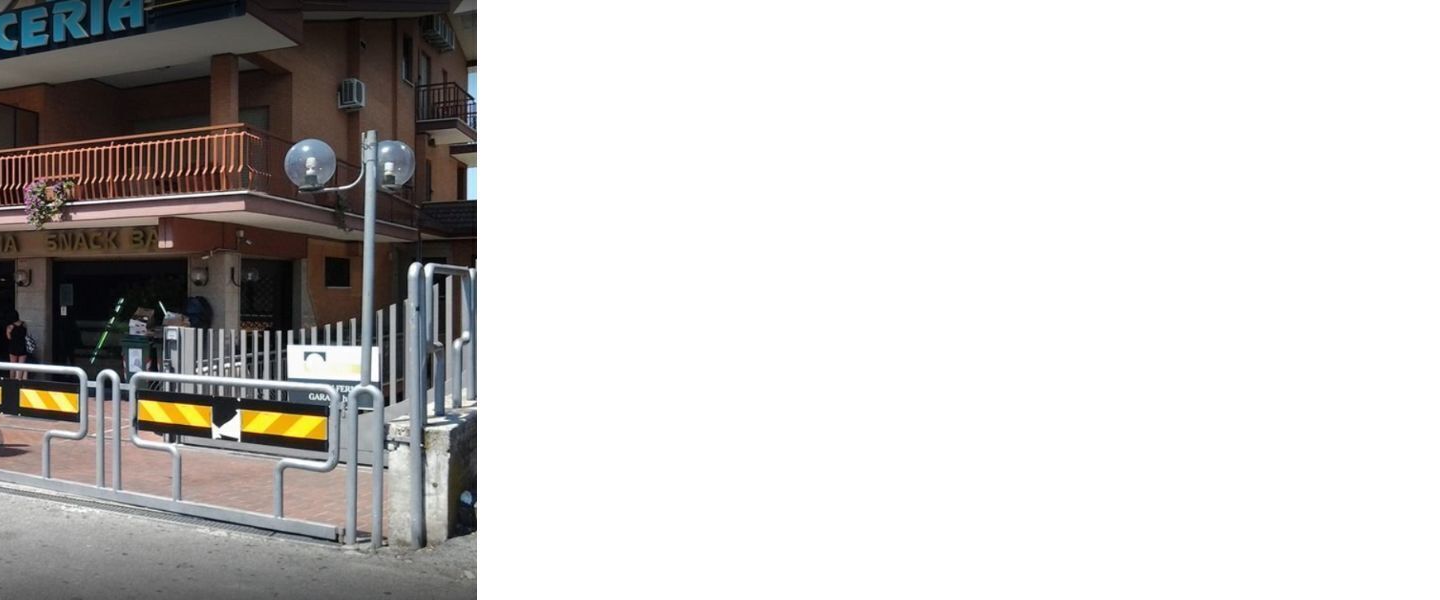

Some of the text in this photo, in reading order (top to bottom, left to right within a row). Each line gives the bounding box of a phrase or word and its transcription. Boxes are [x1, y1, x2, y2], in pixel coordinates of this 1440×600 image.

[46, 227, 159, 252] SNACK BA
[308, 392, 331, 401] GARA
